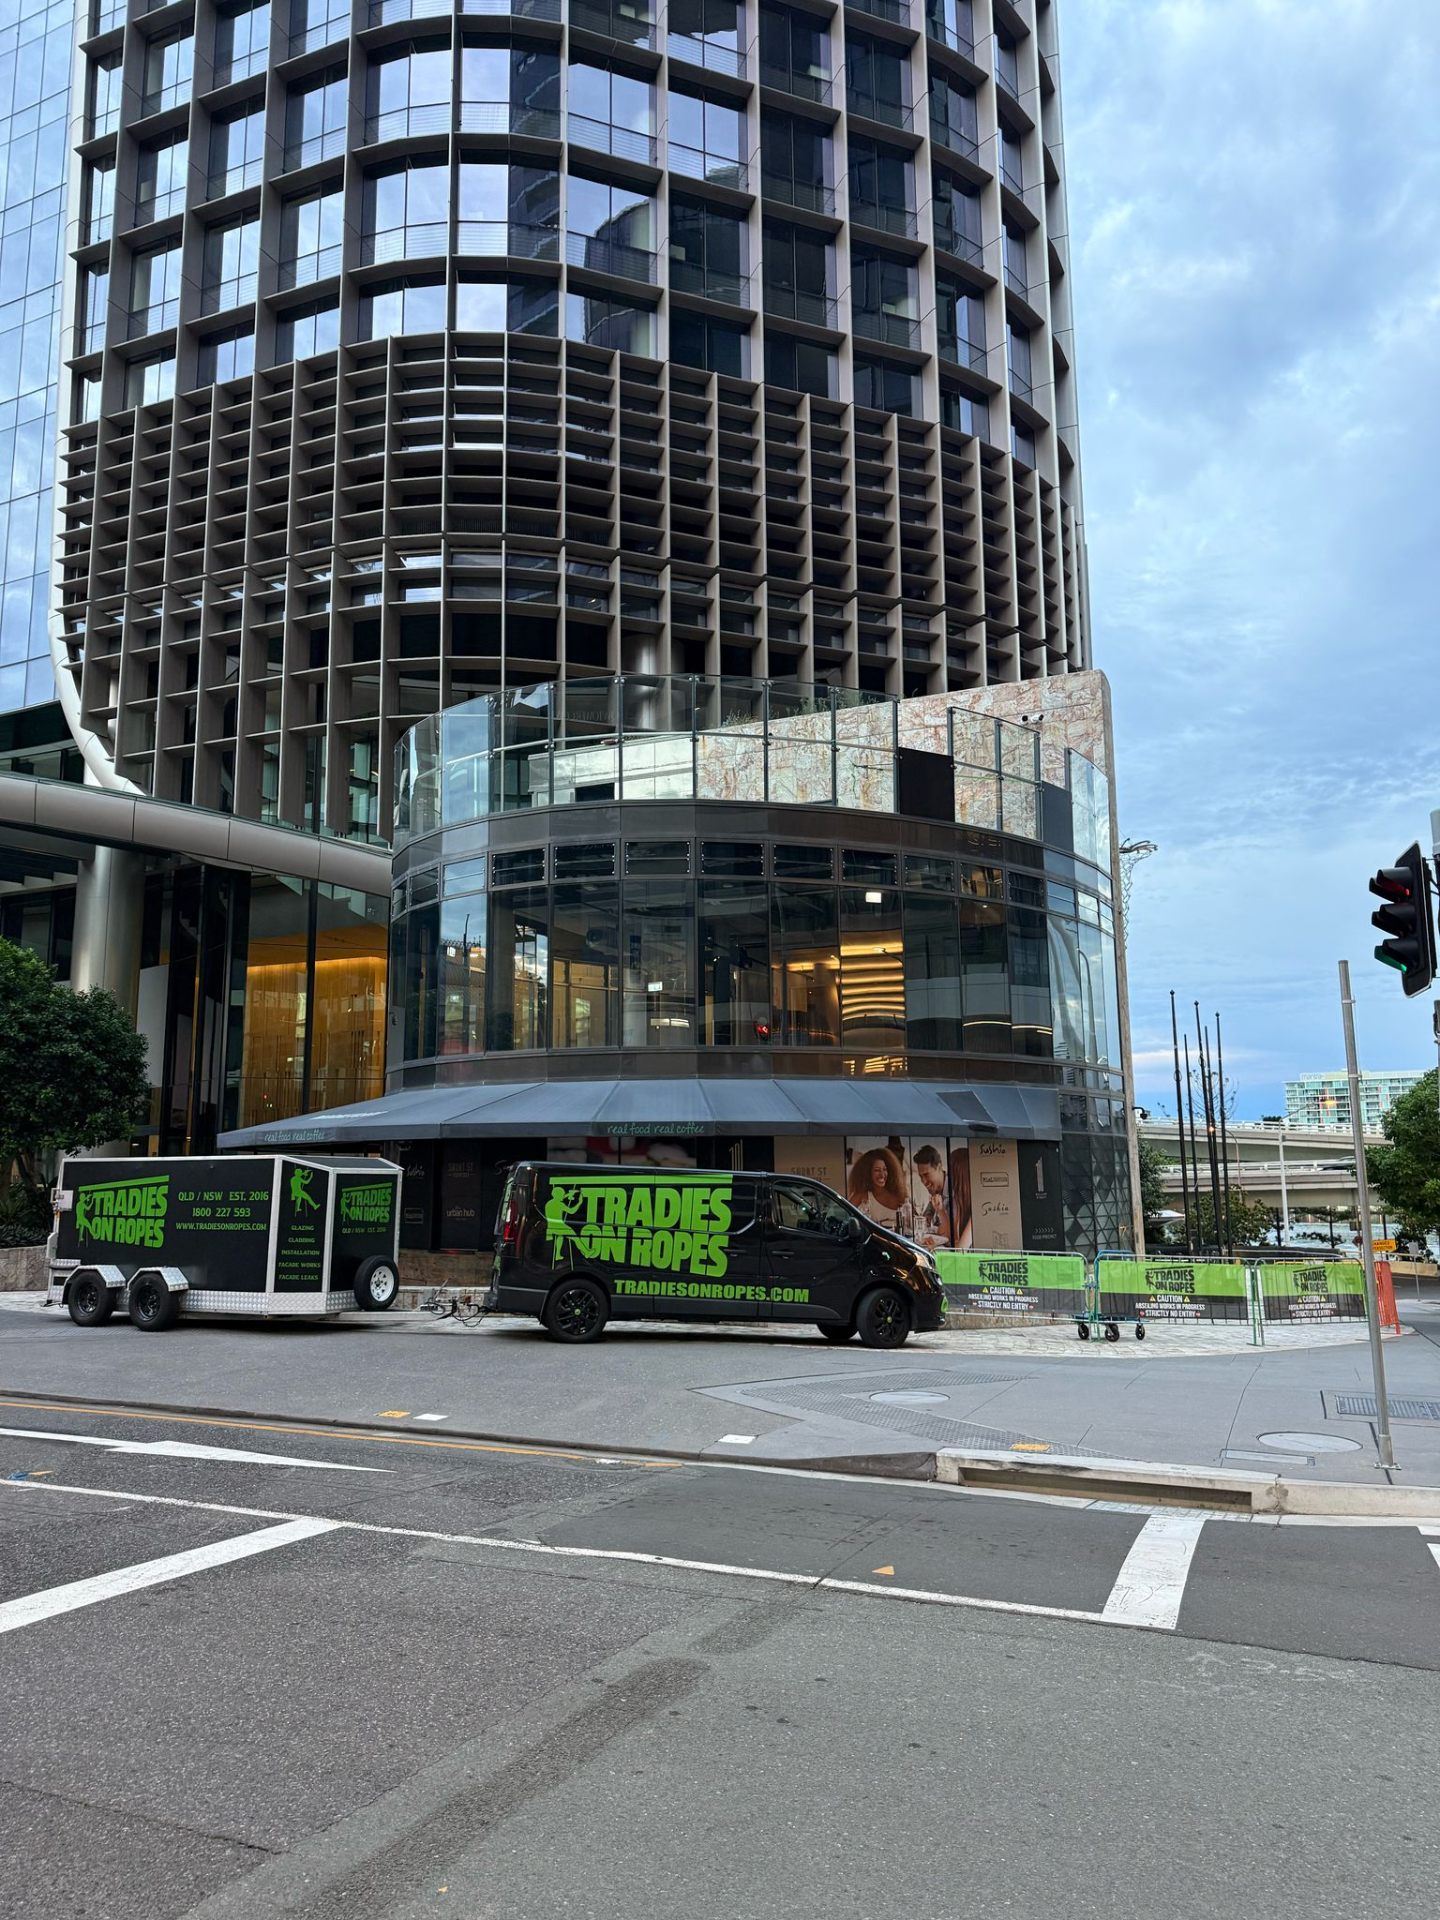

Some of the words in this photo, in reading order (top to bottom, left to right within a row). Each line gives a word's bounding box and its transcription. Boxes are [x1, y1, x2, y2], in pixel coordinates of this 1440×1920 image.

[608, 1123, 627, 1134] real
[629, 1123, 650, 1134] food
[654, 1123, 674, 1134] real
[676, 1122, 704, 1134] coffee
[264, 1131, 277, 1142] real
[278, 1130, 291, 1141] food
[292, 1130, 306, 1141] real
[306, 1128, 325, 1140] coffee
[93, 1185, 169, 1217] TRADIES
[178, 1191, 195, 1202] QLD
[203, 1191, 223, 1201] NSW
[229, 1191, 247, 1201] EST.
[249, 1191, 269, 1201] 2016
[351, 1188, 392, 1207] TRADIES
[192, 1207, 211, 1217] 1800
[215, 1207, 231, 1217] 227
[234, 1207, 251, 1217] 593
[350, 1206, 363, 1221] ON
[363, 1207, 391, 1223] ROPES
[581, 1187, 733, 1233] TRADIES
[91, 1216, 114, 1242] ON
[114, 1217, 165, 1248] ROPES
[175, 1222, 267, 1231] WWW.TRADIESONROPES.COM
[579, 1224, 628, 1264] ON
[630, 1226, 729, 1278] ROPES
[988, 1261, 1029, 1275] TRADIES
[988, 1273, 1001, 1283] ON
[1001, 1274, 1029, 1286] ROPES
[1154, 1269, 1195, 1282] TRADIES
[1299, 1269, 1327, 1282] TRADIES
[614, 1279, 809, 1303] TRADIESONROPES.COM
[989, 1286, 1016, 1295] CAUTION
[1155, 1281, 1168, 1291] ON
[1168, 1282, 1195, 1294] ROPES
[1309, 1281, 1328, 1293] ROPES
[977, 1300, 1001, 1308] STRICTLY
[1002, 1301, 1011, 1309] NO
[1011, 1302, 1029, 1310] ENTRY
[991, 1294, 1008, 1302] WORKS
[1014, 1295, 1039, 1304] PROGRESS
[1156, 1294, 1183, 1303] CAUTION
[1302, 1295, 1320, 1303] CAUTION
[1145, 1309, 1169, 1317] STRICTLY
